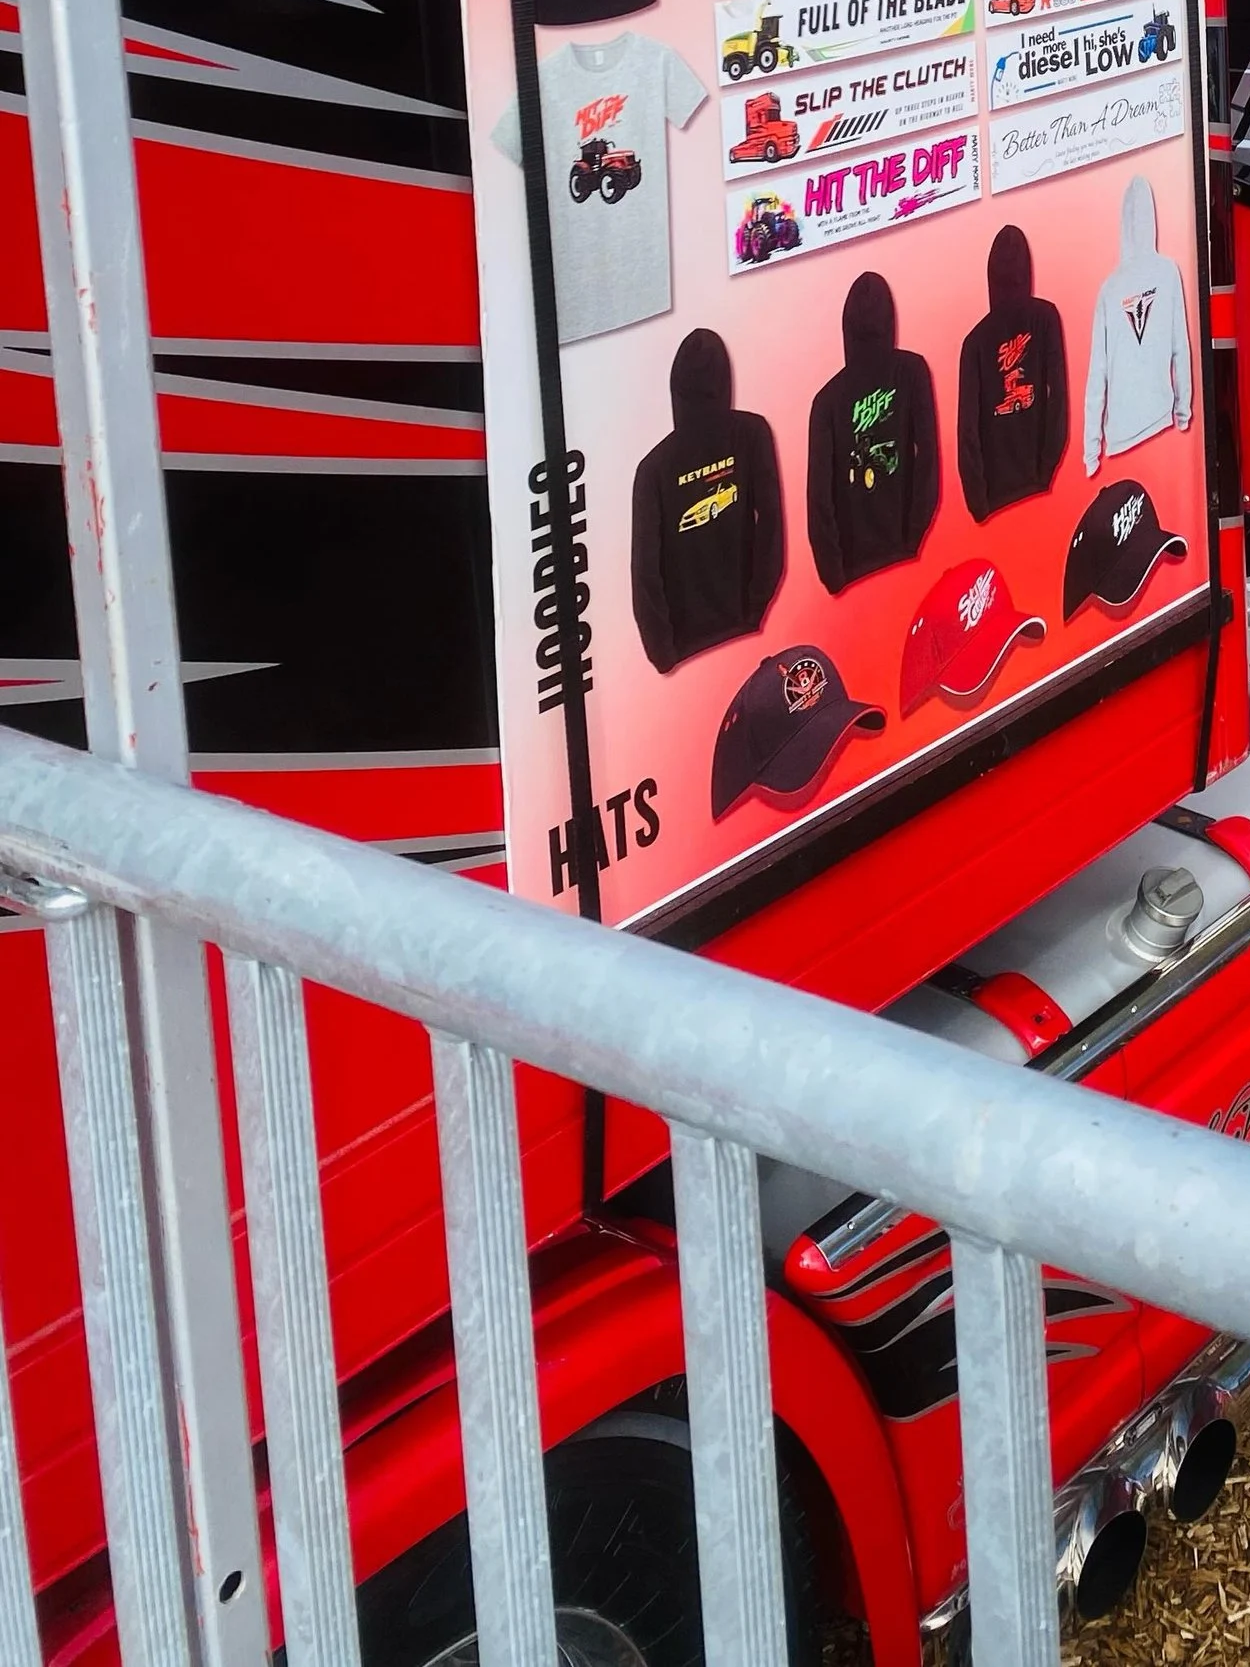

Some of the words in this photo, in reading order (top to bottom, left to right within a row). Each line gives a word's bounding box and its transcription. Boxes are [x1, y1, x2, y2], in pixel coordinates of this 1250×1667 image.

[798, 1, 840, 37] FULL
[1021, 33, 1025, 49] I
[1029, 26, 1055, 47] need
[1043, 41, 1067, 56] more
[1084, 34, 1097, 52] hi,
[1100, 27, 1126, 47] she's
[1018, 38, 1080, 81] diesel
[1086, 41, 1135, 76] LOW
[795, 86, 842, 116] SLIP
[850, 75, 887, 102] THE
[893, 56, 967, 92] CLUTCH
[1002, 129, 1049, 160] Better
[1050, 114, 1089, 144] Than
[1091, 104, 1109, 135] A
[1111, 98, 1159, 127] Dream
[804, 167, 850, 216] HIT
[853, 152, 906, 205] THE
[912, 135, 967, 186] DIFF
[972, 165, 980, 191] MONE
[678, 456, 735, 485] KEYBANG
[549, 778, 660, 897] HATS
